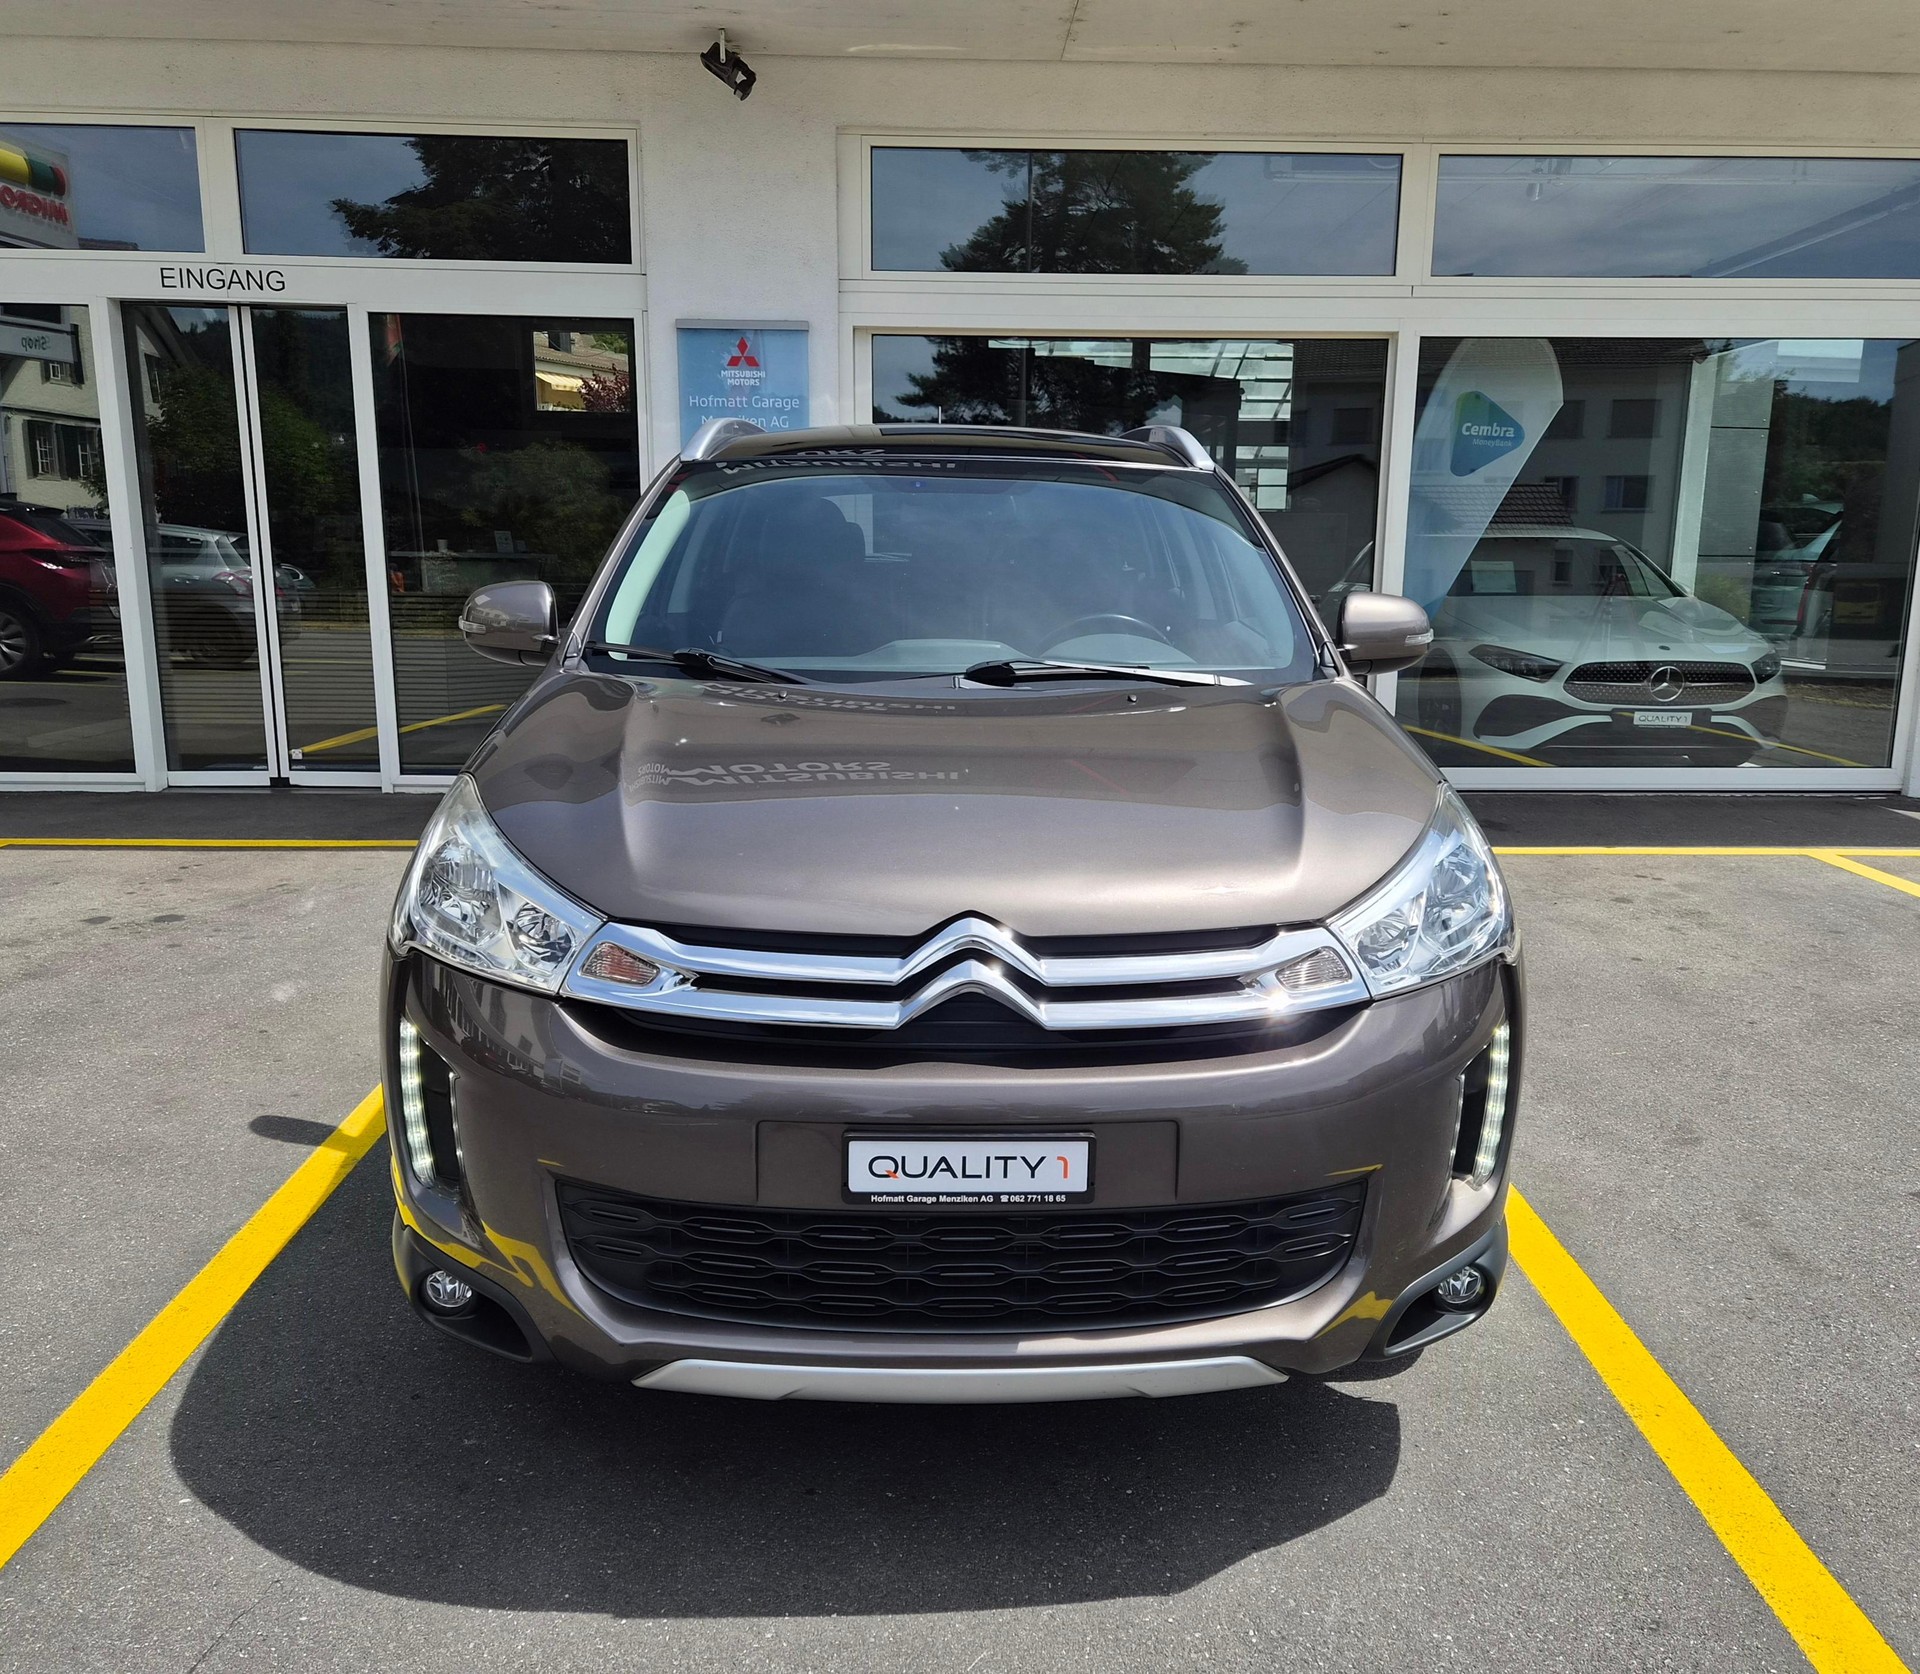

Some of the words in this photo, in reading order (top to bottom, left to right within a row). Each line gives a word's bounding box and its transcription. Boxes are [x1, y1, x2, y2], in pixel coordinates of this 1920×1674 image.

[160, 267, 286, 292] EINGANG
[721, 370, 766, 378] MITSUBISHI
[689, 395, 748, 408] Hofmatt
[752, 395, 800, 411] Garage
[770, 415, 789, 428] AG
[1461, 422, 1515, 437] Cembra
[1638, 715, 1681, 723] QUALITY
[868, 1155, 1047, 1179] QUALITY
[1056, 1156, 1069, 1179] 1
[870, 1194, 904, 1203] Hofmatt
[906, 1194, 937, 1205] Garage
[939, 1194, 979, 1203] Menziken
[980, 1194, 994, 1203] AG
[1010, 1194, 1025, 1203] 062
[1027, 1194, 1041, 1203] 771
[1044, 1194, 1054, 1203] 18
[1055, 1194, 1067, 1203] 65
